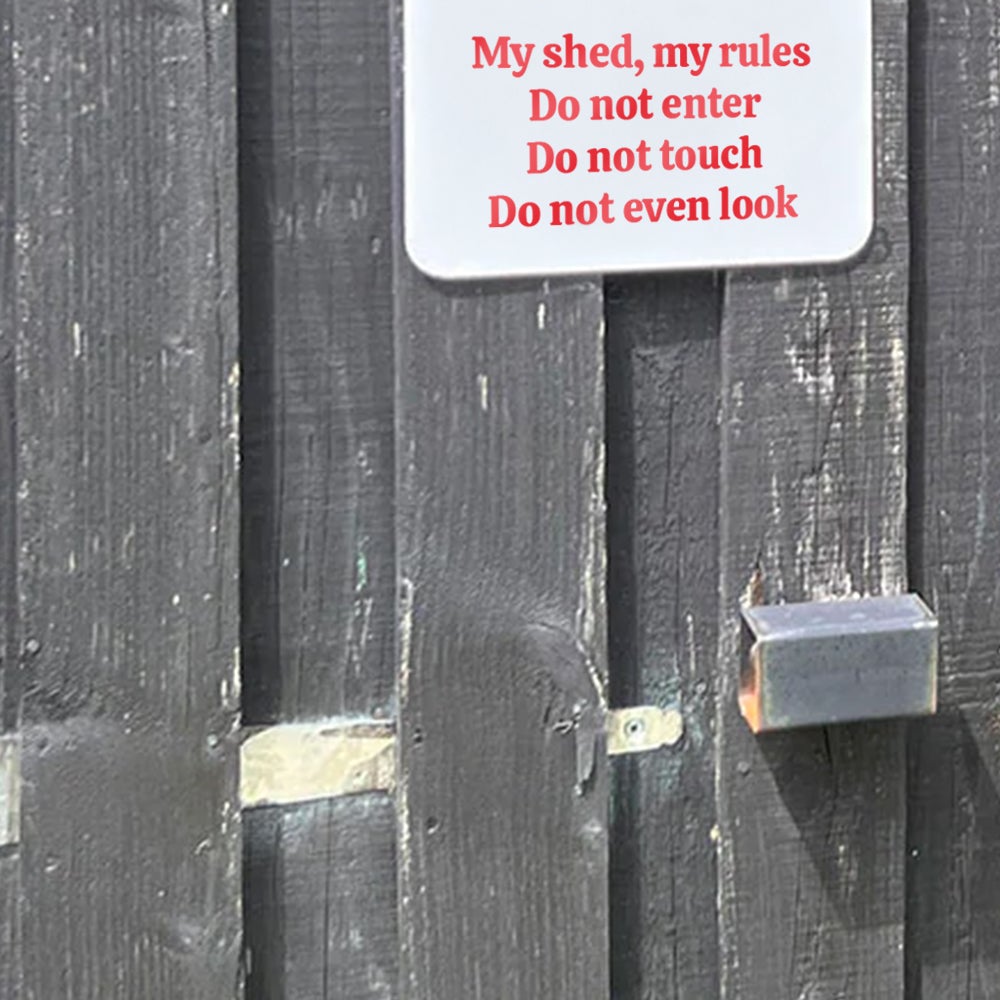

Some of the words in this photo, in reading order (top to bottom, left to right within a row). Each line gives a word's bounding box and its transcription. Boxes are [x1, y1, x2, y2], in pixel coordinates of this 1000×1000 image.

[471, 35, 536, 79] My
[542, 32, 645, 78] shed,
[652, 42, 713, 77] my
[718, 32, 811, 69] rules
[529, 87, 581, 122] Do
[589, 87, 655, 121] not
[661, 87, 763, 120] enter
[526, 140, 579, 175] Do
[586, 139, 653, 174] not
[659, 134, 763, 172] touch
[488, 194, 542, 229] Do
[548, 192, 616, 227] not
[623, 196, 711, 224] even
[718, 184, 799, 221] look
